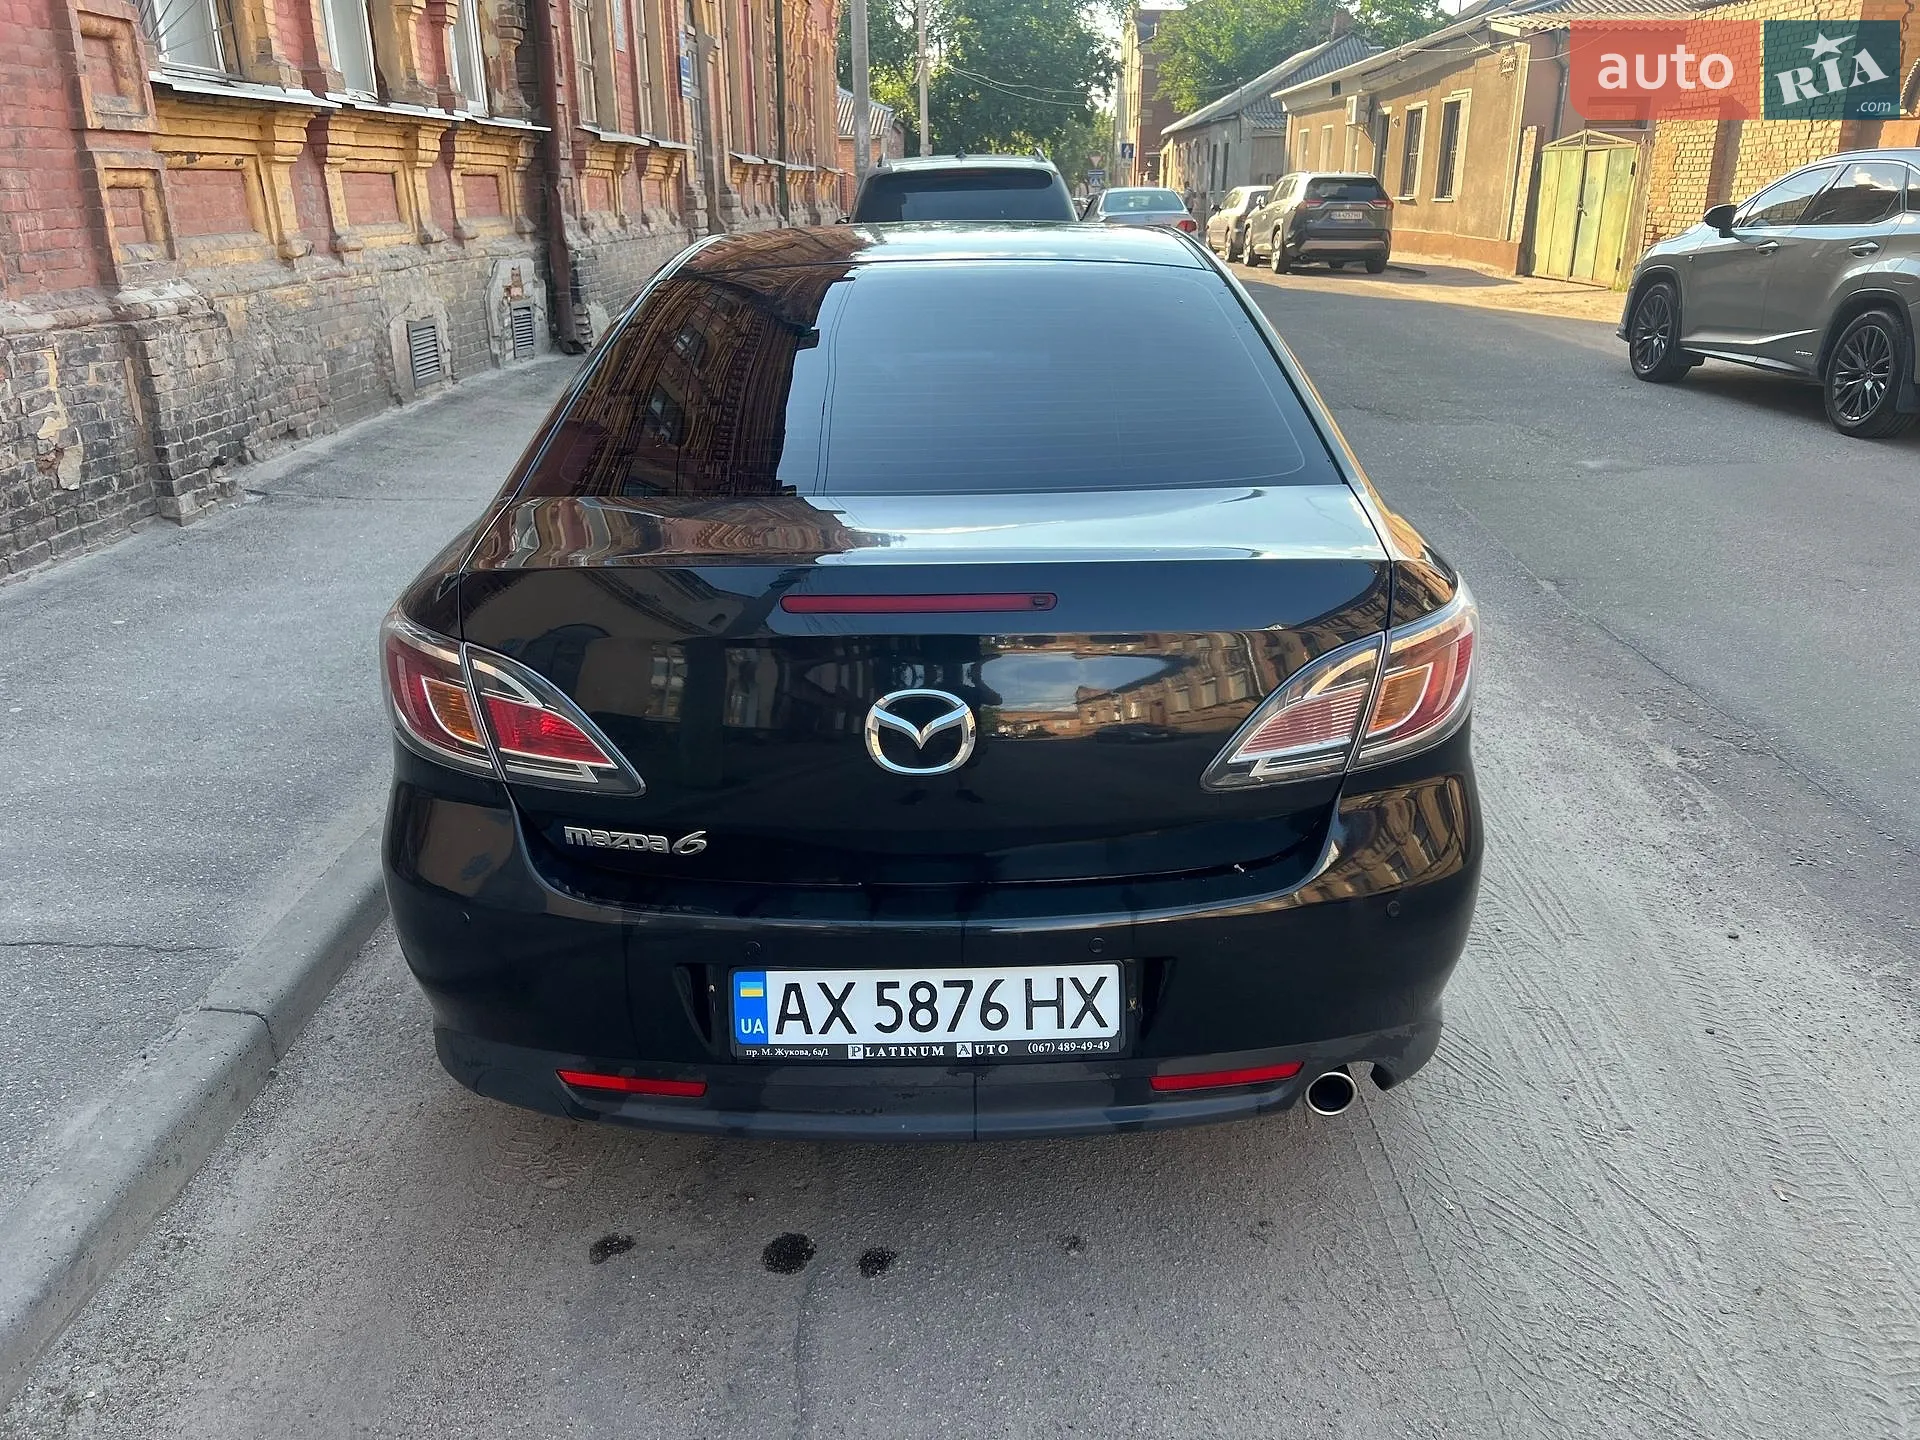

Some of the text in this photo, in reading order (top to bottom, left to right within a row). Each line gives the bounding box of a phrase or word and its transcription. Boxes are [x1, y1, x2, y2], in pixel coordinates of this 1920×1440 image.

[775, 976, 1108, 1035] AX 5876 HX
[740, 1018, 765, 1035] UA
[774, 1047, 812, 1058] Жукова,
[1027, 1040, 1110, 1054] (067) 489-49-49
